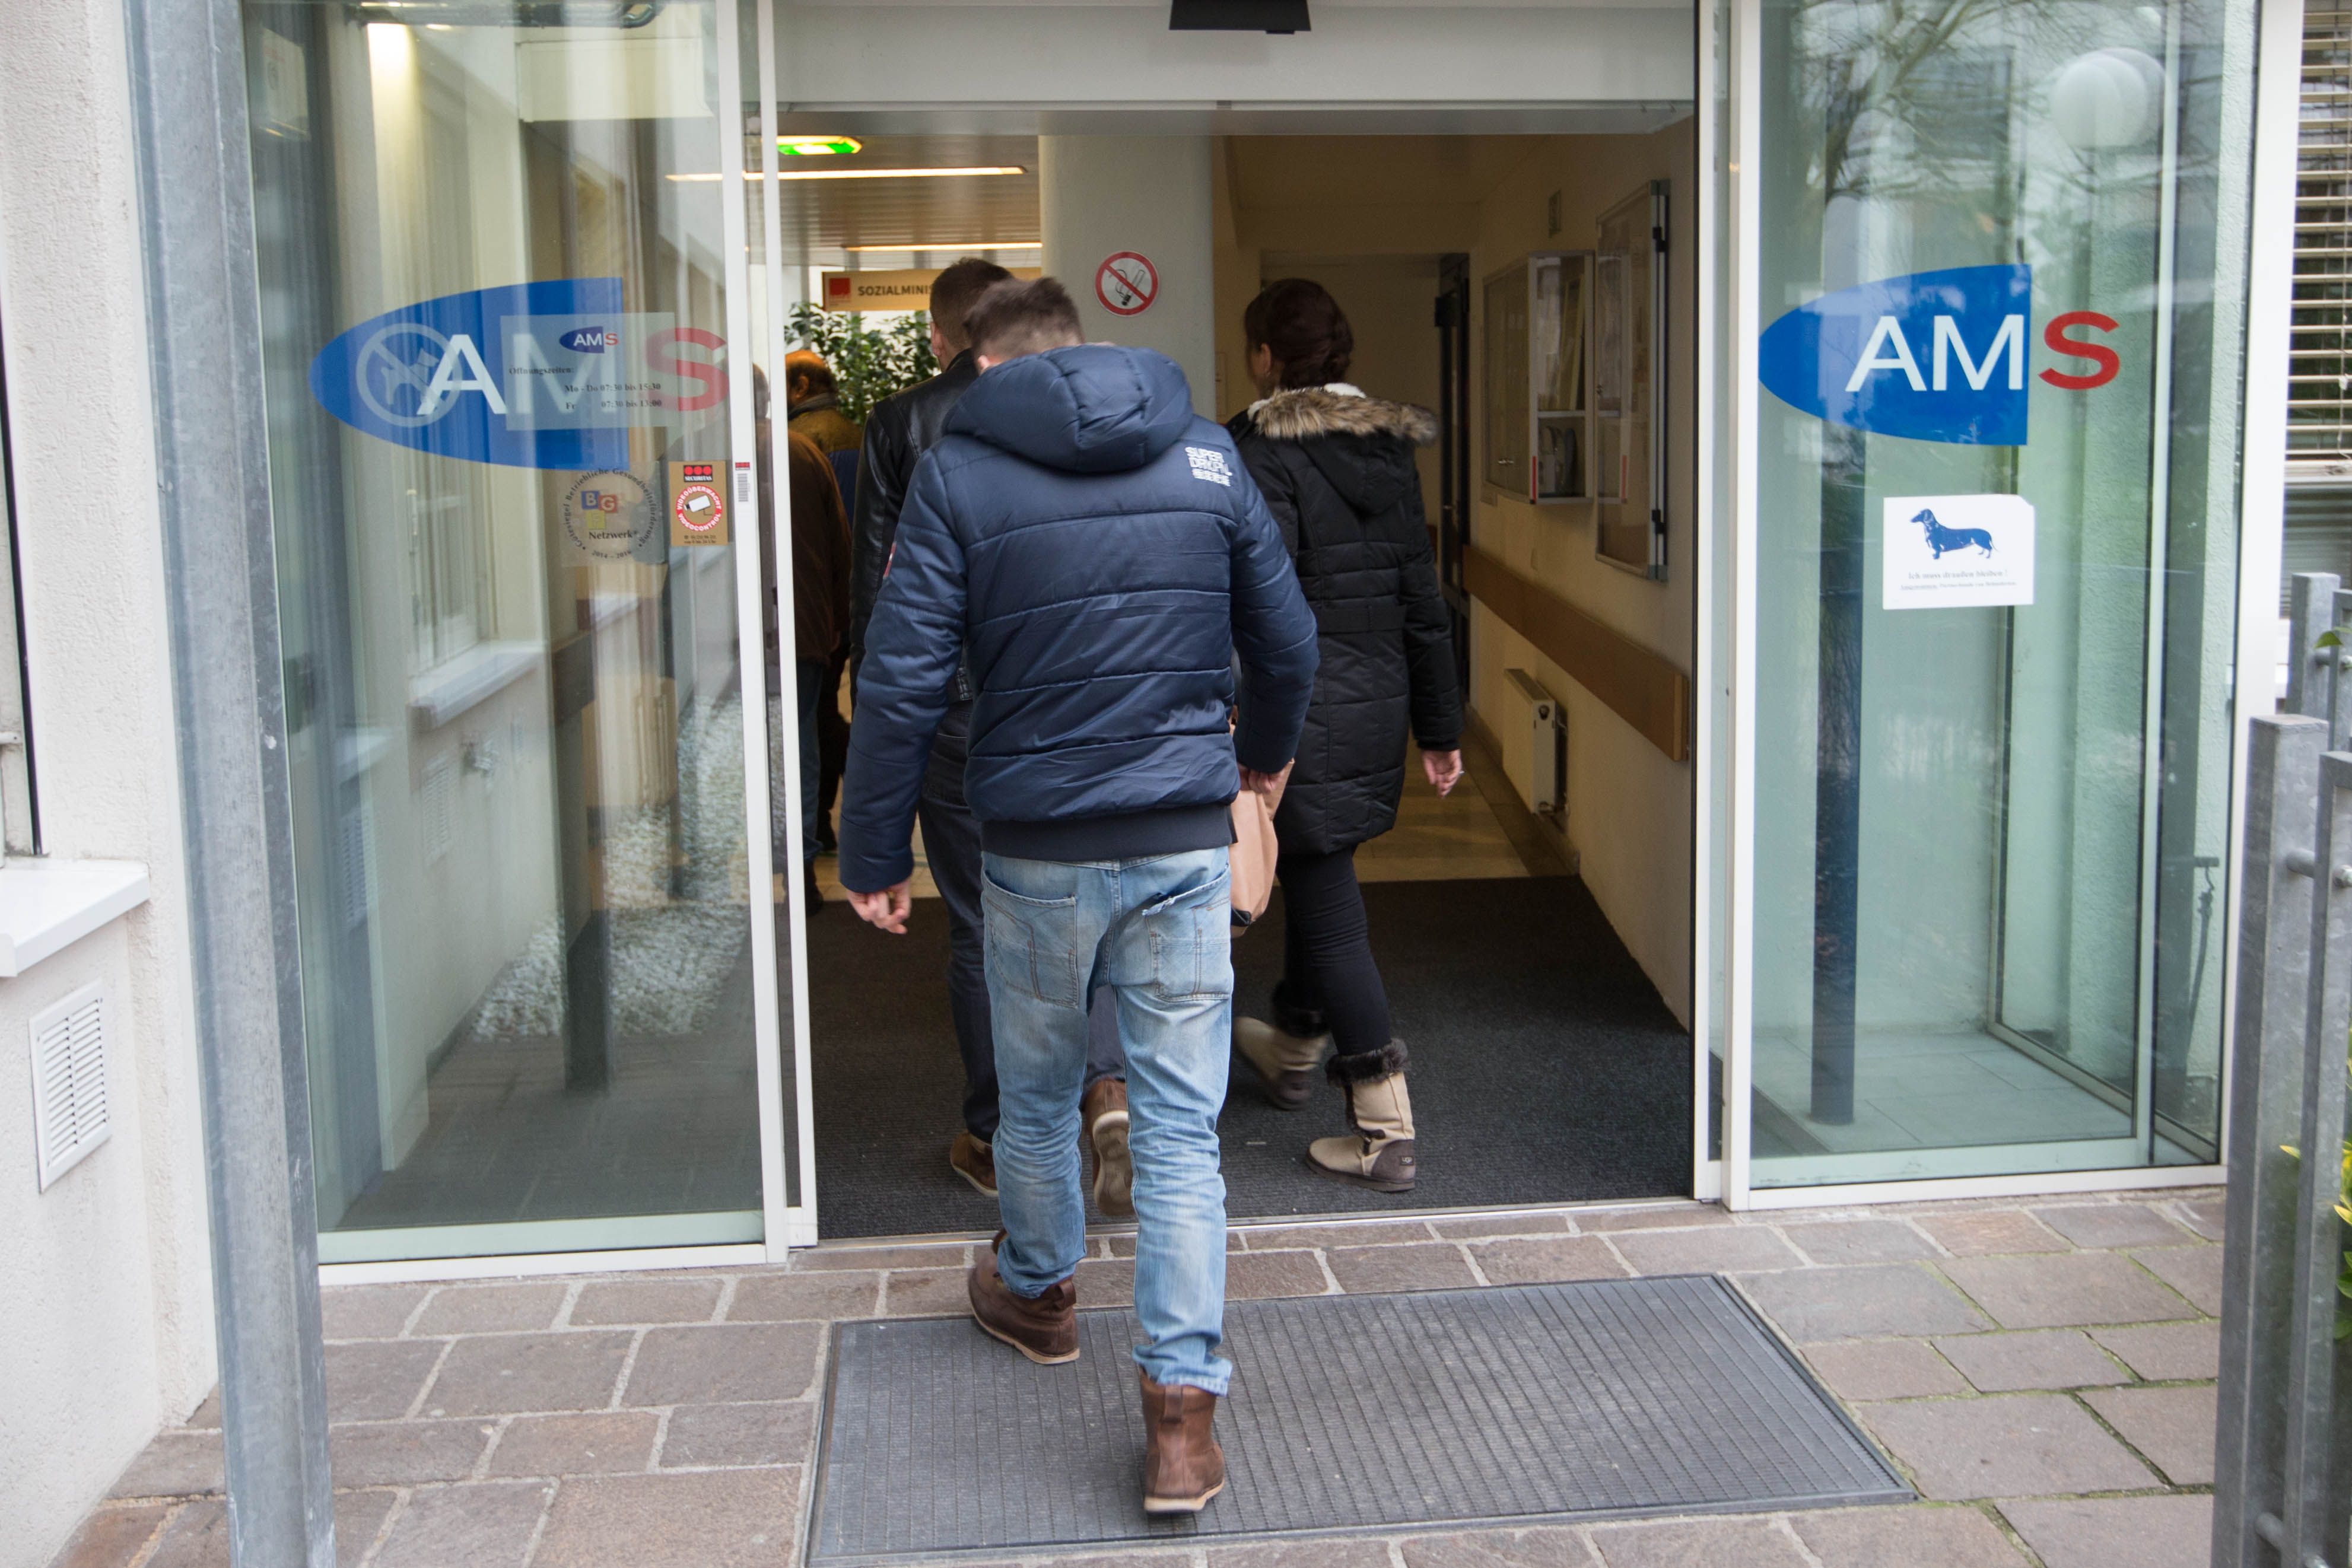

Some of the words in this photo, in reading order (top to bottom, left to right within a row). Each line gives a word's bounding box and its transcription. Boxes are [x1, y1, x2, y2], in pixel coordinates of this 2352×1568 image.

[573, 333, 619, 346] AMS
[1845, 310, 2120, 392] AMS
[417, 327, 729, 415] AMS
[625, 383, 637, 392] bis
